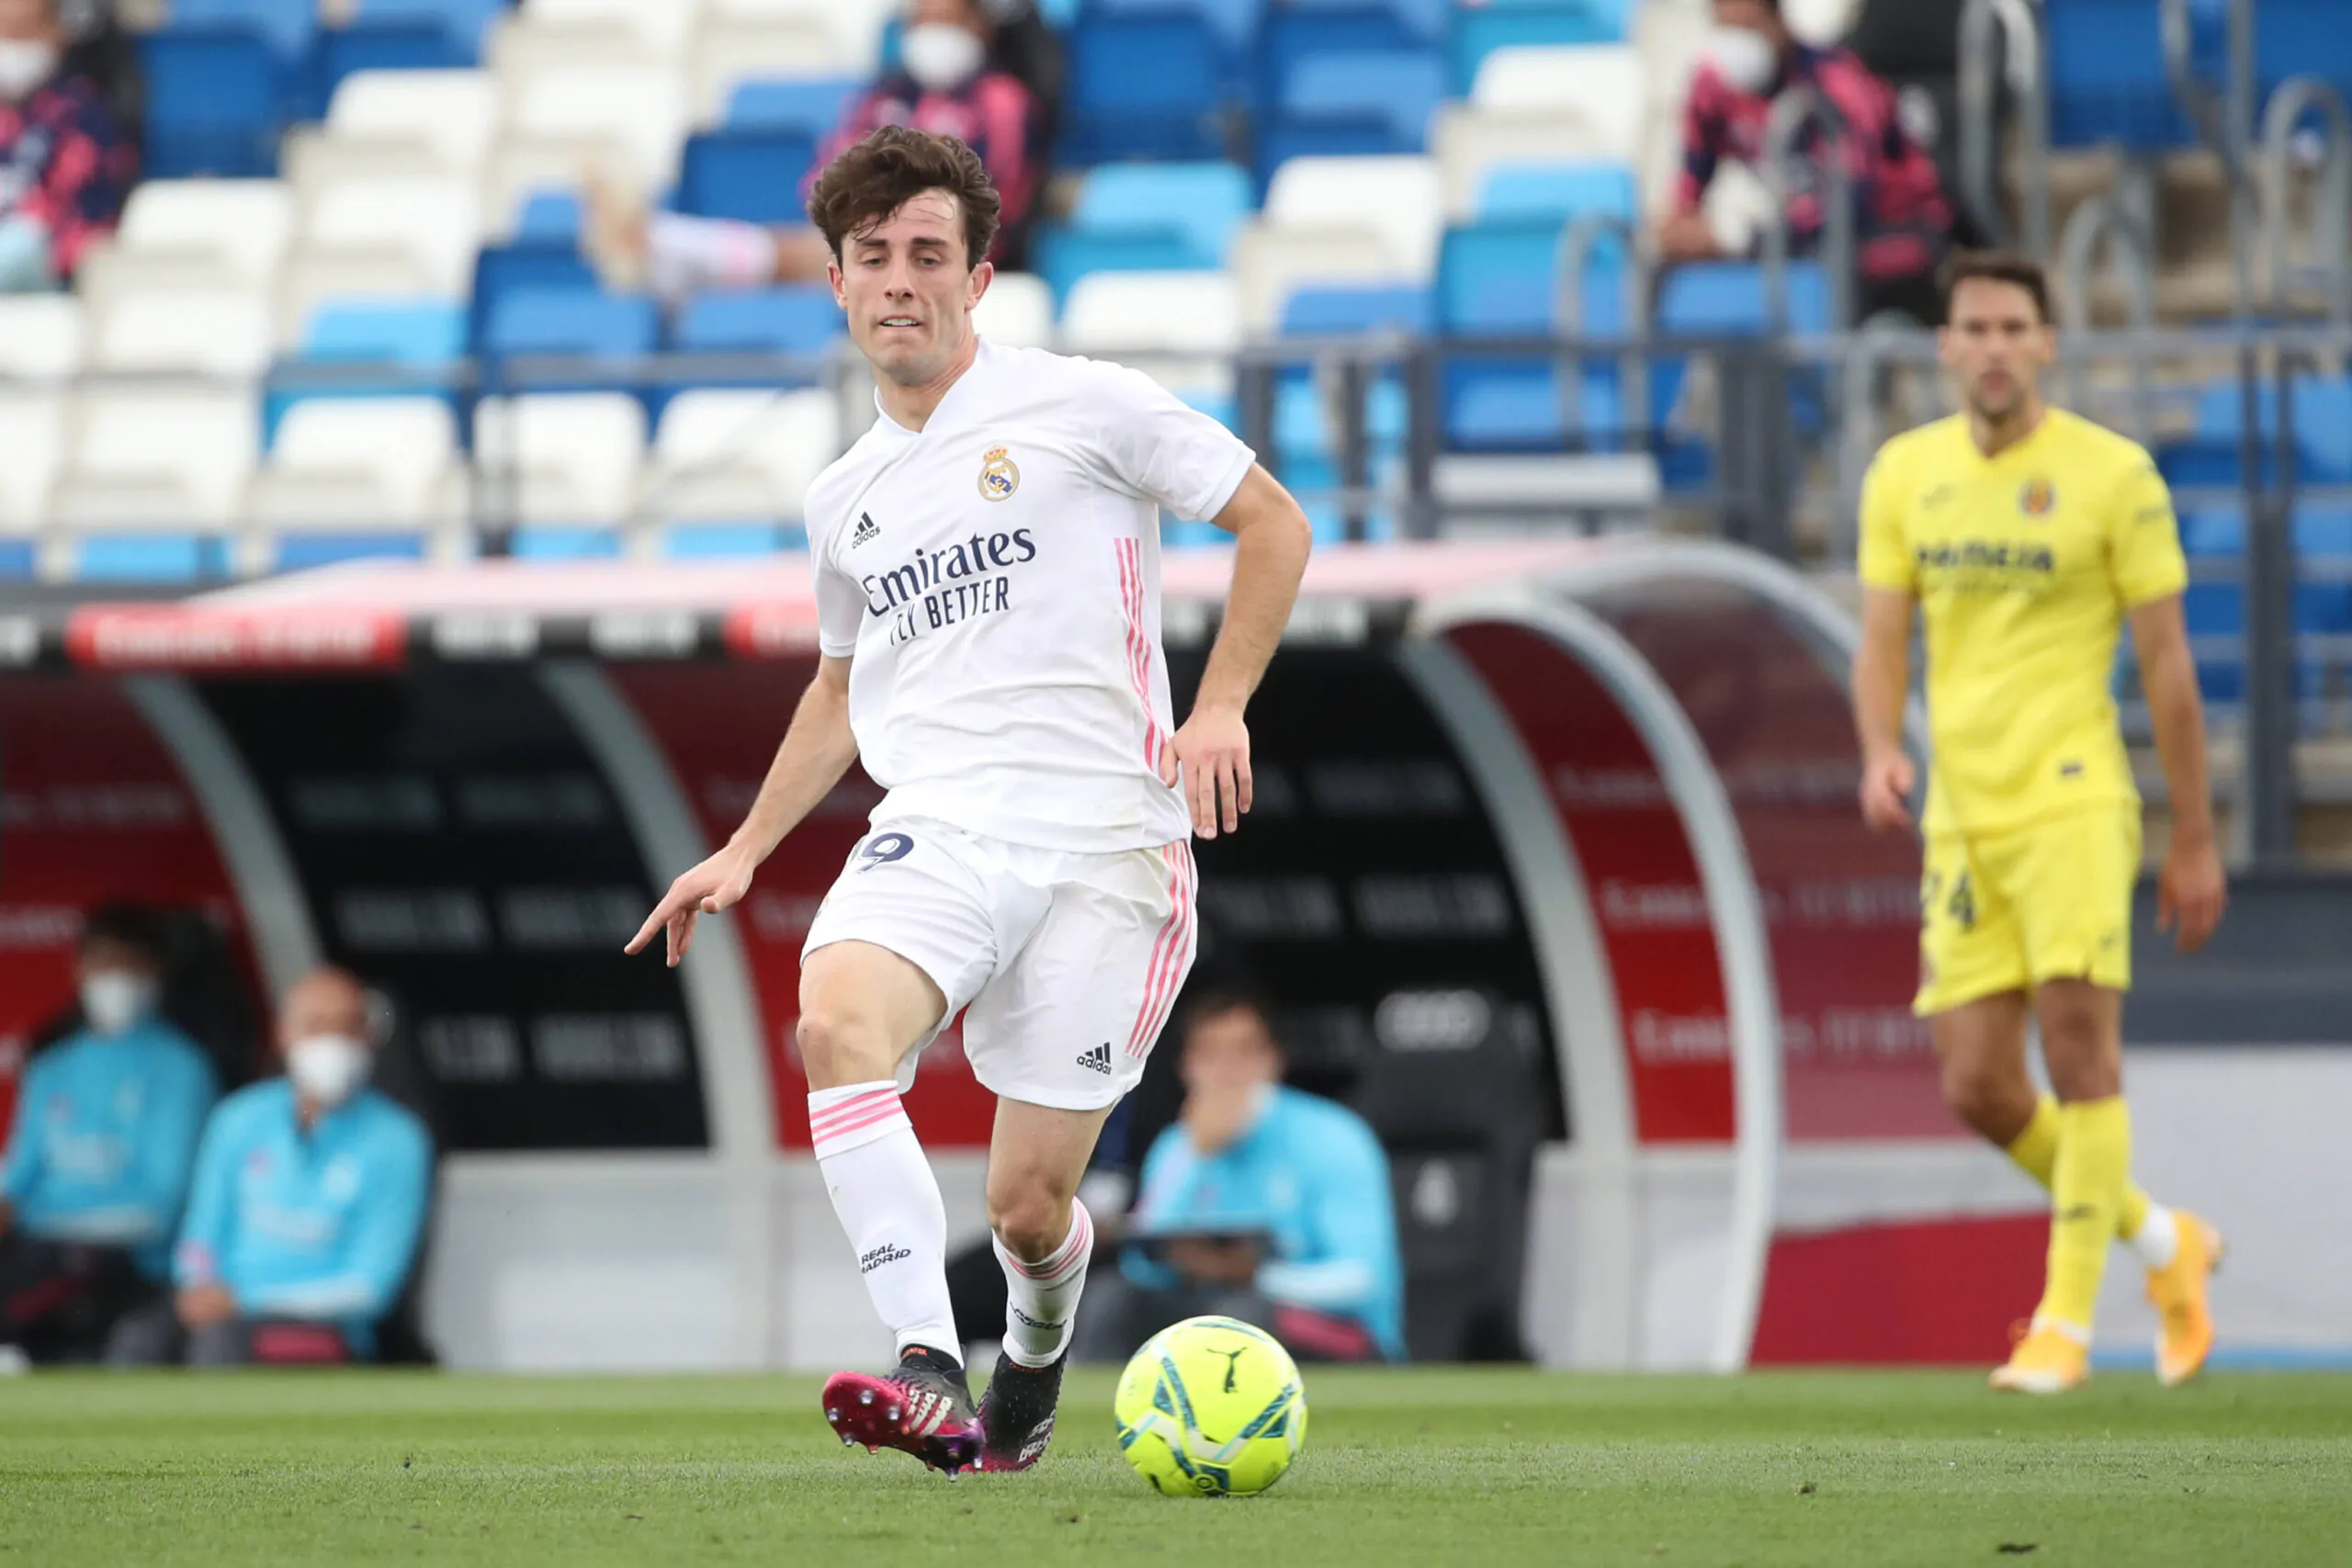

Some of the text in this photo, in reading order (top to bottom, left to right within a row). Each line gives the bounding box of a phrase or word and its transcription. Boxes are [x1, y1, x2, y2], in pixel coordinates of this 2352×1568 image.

[852, 526, 881, 549] adidas
[862, 528, 1036, 617] Emirates
[924, 576, 1010, 629] BETTER
[1076, 1055, 1112, 1076] adidas
[861, 1243, 896, 1265] REAL
